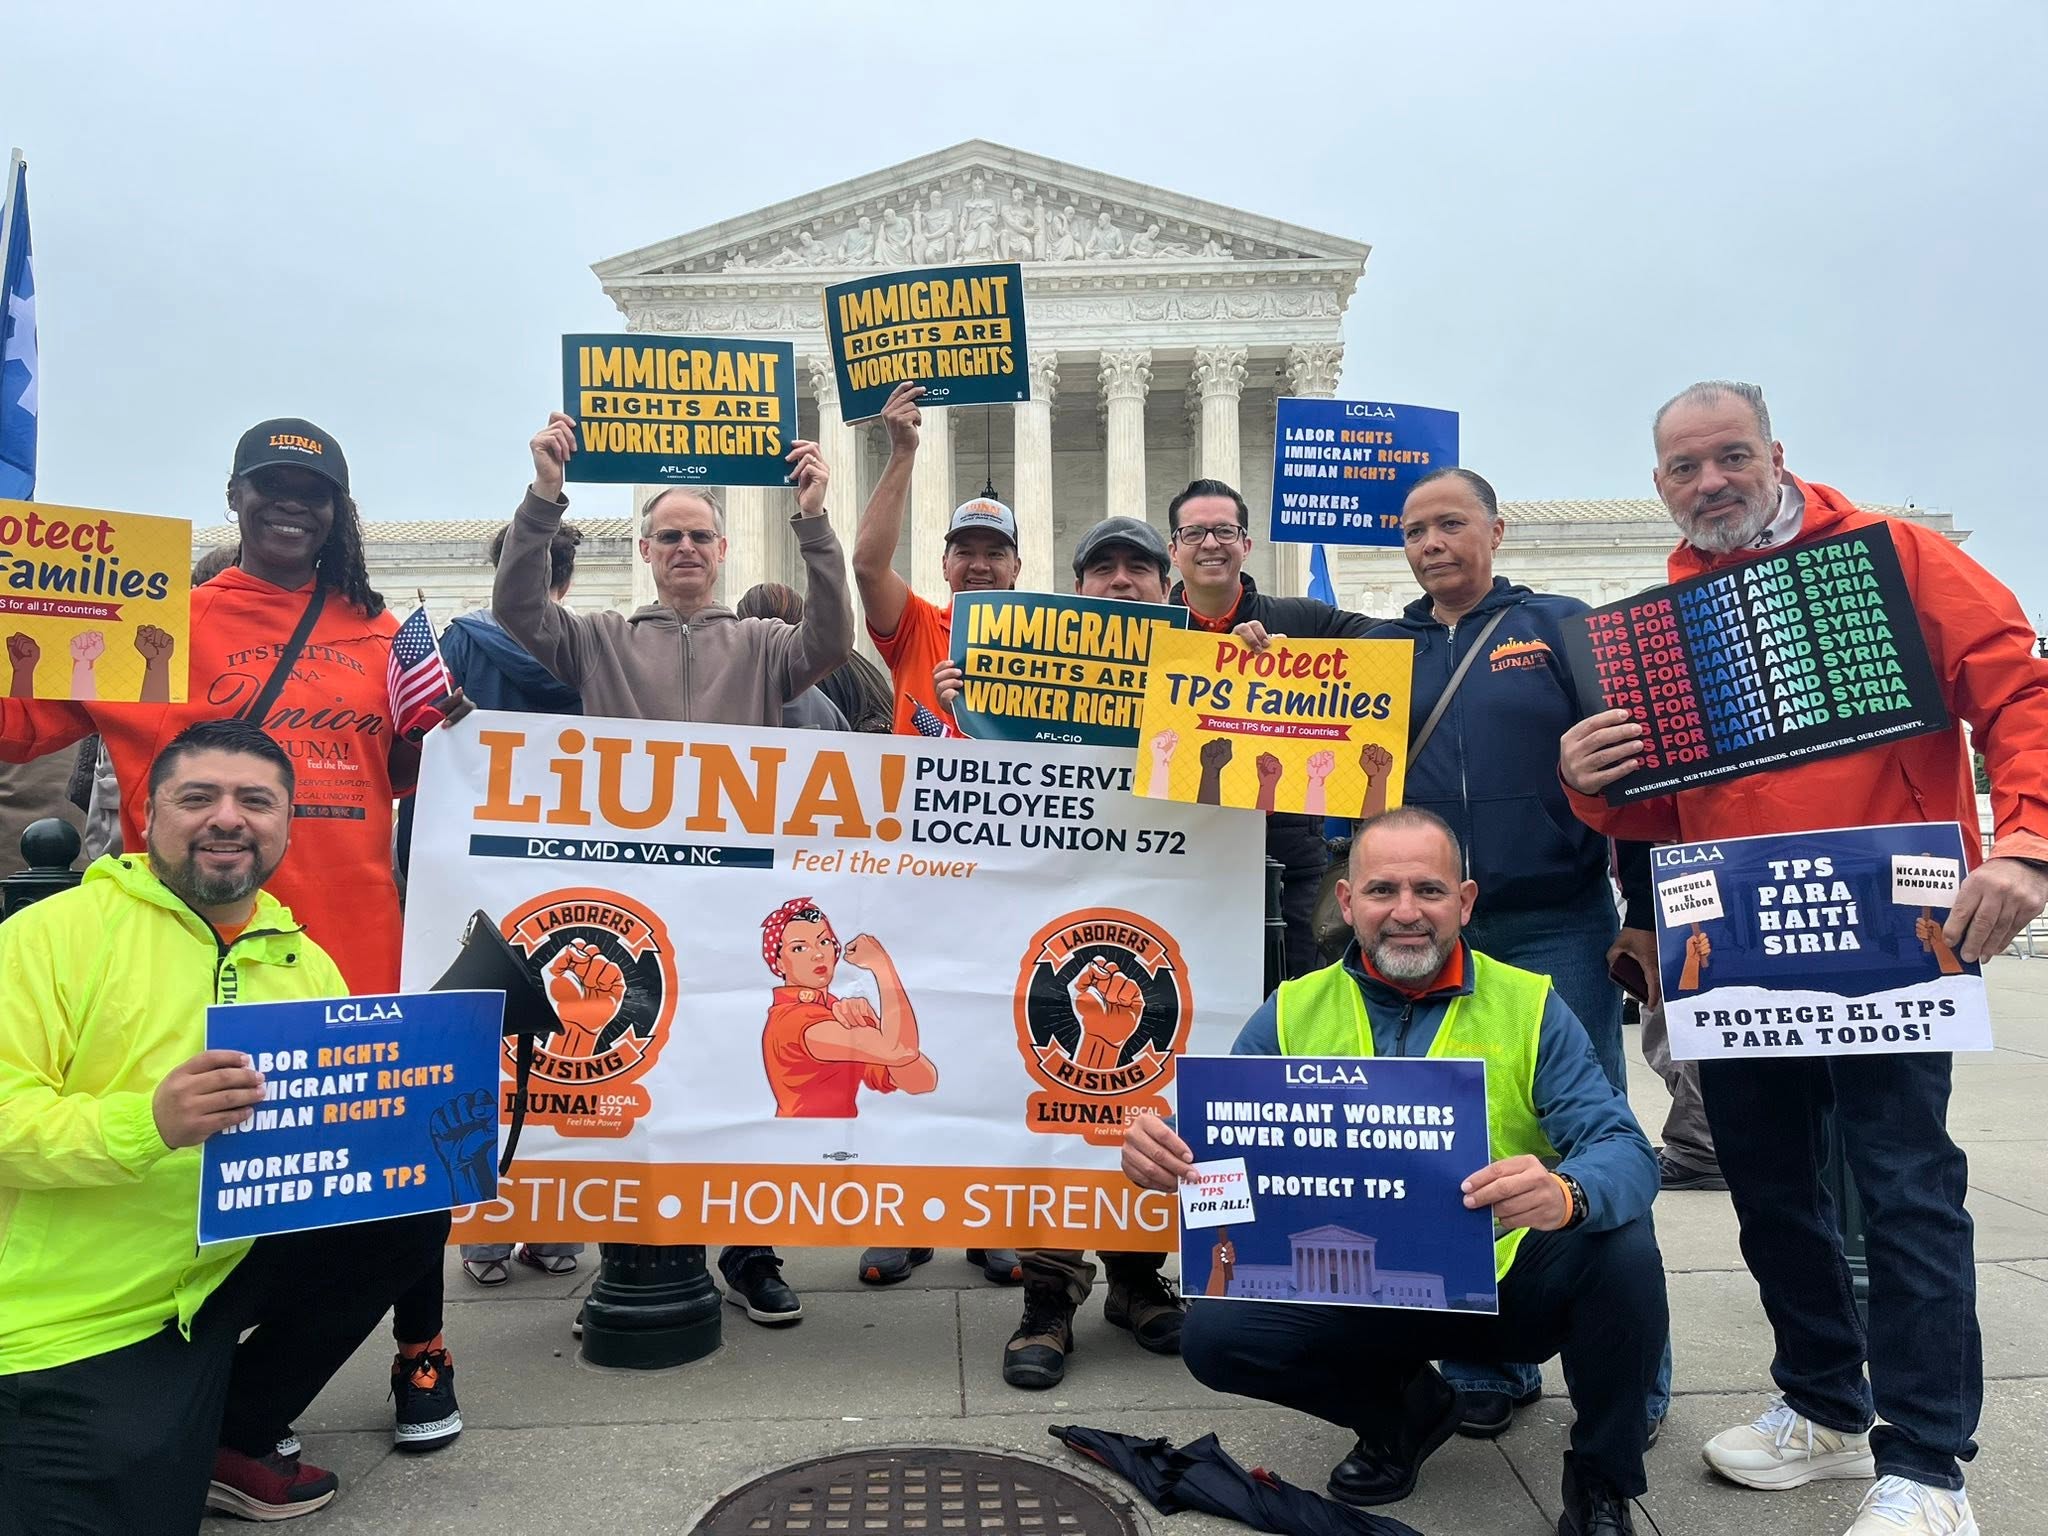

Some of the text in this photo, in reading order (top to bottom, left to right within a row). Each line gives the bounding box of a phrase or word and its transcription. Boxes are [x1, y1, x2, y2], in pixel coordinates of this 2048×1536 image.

[839, 276, 1008, 333] IMMIGRANT
[851, 323, 1002, 354] RIGHTS ARE
[579, 346, 779, 393] IMMIGRANT
[847, 346, 1014, 391] WORKER RIGHTS
[591, 396, 770, 417] RIGHTS ARE
[1346, 404, 1395, 418] LCLAA
[581, 422, 780, 456] WORKER RIGHTS
[1286, 428, 1392, 444] LABOR RIGHTS
[1285, 446, 1429, 464] IMMIGRANT RIGHTS
[659, 465, 707, 474] AFL-CIO
[1284, 464, 1396, 481] HUMAN RIGHTS
[1283, 493, 1359, 510] WORKERS
[1281, 511, 1372, 528] UNITED FOR
[0, 512, 115, 554] otect
[1585, 540, 1869, 630] TPS FOR HAITI AND SYRIA
[9, 600, 23, 610] for
[27, 601, 39, 611] all
[42, 603, 54, 612] 17
[58, 604, 108, 616] countries
[1588, 557, 1874, 645] TPS FOR HAITI AND SYRIA
[1592, 574, 1878, 660] TPS FOR HAITI AND SYRIA
[1596, 590, 1884, 676] TPS FOR HAITI AND SYRIA
[227, 646, 268, 667] IT'S
[1215, 641, 1349, 680] Protect
[1599, 608, 1888, 692] TPS FOR HAITI AND SYRIA
[977, 654, 1085, 682] RIGHTS
[964, 680, 1144, 729] WORKER RIGHT
[1166, 673, 1392, 720] TPS Families
[1036, 732, 1082, 743] AFL-CIO
[1208, 719, 1339, 736] Protect TPS for all 17 countries
[1666, 744, 1710, 766] FOR
[1715, 722, 1776, 754] HAITI
[1782, 708, 1830, 733] AND
[1836, 693, 1912, 718] SYRIA
[307, 760, 358, 770] Feel the Power
[1625, 787, 1639, 796] OUR
[1640, 777, 1681, 792] NEIGHBORS.
[1683, 772, 1698, 782] OUR
[1699, 763, 1738, 779] TEACHERS.
[1739, 759, 1754, 768] OUR
[1755, 752, 1788, 766] FRIENDS.
[1789, 747, 1806, 757] OUR
[1806, 737, 1855, 753] CAREGIVERS.
[1857, 732, 1873, 741] OUR
[1874, 720, 1924, 737] COMMUNITY.
[473, 729, 906, 843] LiUNA!
[916, 757, 1135, 791] PUBLIC SERVI
[914, 789, 1095, 820] EMPLOYEES
[912, 820, 1186, 854] LOCAL UNION 572
[792, 849, 978, 879] Feel the Power
[1656, 845, 1724, 867] LCLAA
[1768, 857, 1834, 881] TPS
[1896, 866, 1956, 878] NICARAGUA
[1661, 879, 1712, 897] VENEZUELA
[1758, 881, 1852, 906] PARA
[1897, 878, 1955, 891] HONDURAS
[1670, 897, 1715, 914] SALVADOR
[1685, 894, 1696, 902] EL
[536, 905, 634, 935] LABORERS
[1758, 902, 1859, 931] HAITÍ
[1060, 925, 1149, 953] LABORERS
[1764, 931, 1861, 956] SIRIA
[325, 1002, 403, 1024] LCLAA
[1694, 999, 1956, 1027] PROTEGE EL TPS
[1722, 1023, 1932, 1048] PARA TODOS!
[318, 1042, 399, 1068] RIGHTS
[377, 1064, 454, 1090] RIGHTS
[1285, 1064, 1369, 1085] LCLAA
[323, 1097, 405, 1124] RIGHTS
[600, 1096, 639, 1106] LOCAL
[600, 1107, 622, 1116] 572
[1037, 1101, 1122, 1124] LiUNA!
[597, 1119, 622, 1127] Power
[1206, 1102, 1455, 1126] IMMIGRANT WORKERS
[1207, 1126, 1456, 1151] POWER OUR ECONOMY
[220, 1148, 349, 1184] WORKERS
[217, 1164, 426, 1211] UNITED FOR TPS
[1200, 1187, 1224, 1196] TPS
[1257, 1175, 1406, 1200] PROTECT TPS
[701, 1181, 1178, 1233] HONOR STRENG
[1190, 1198, 1250, 1213] FOR ALL!
